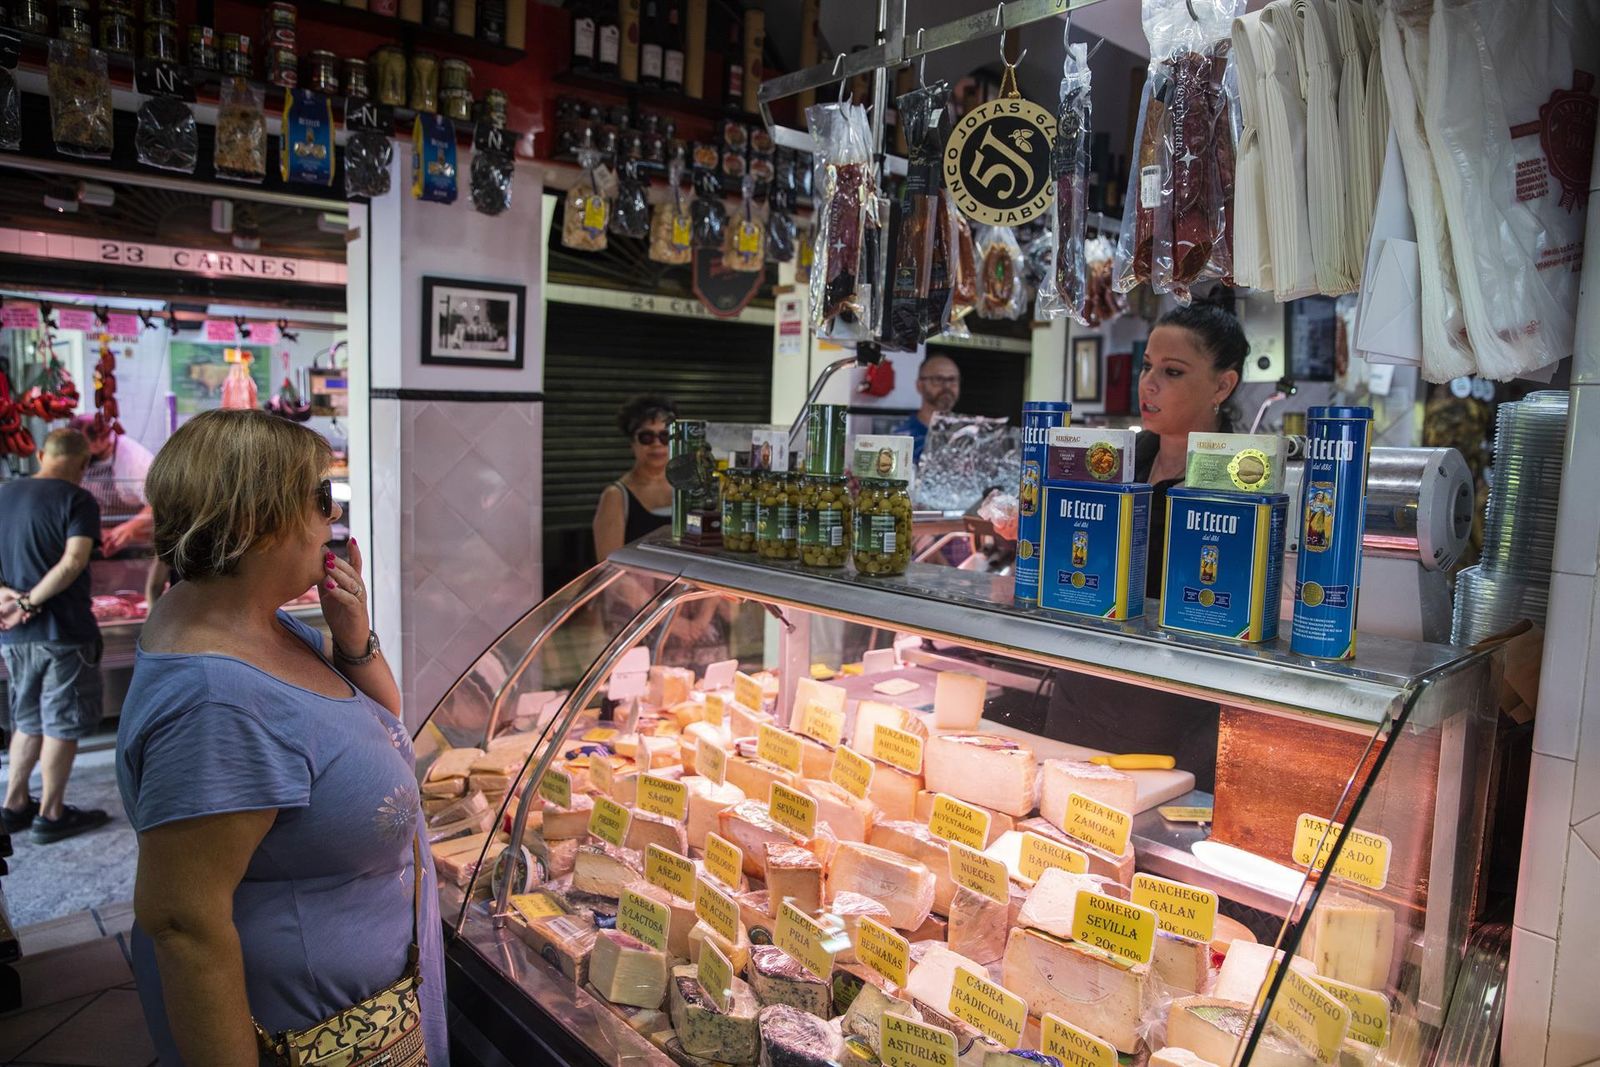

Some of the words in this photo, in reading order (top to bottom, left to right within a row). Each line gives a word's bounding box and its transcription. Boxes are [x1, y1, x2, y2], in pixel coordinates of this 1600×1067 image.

[959, 102, 1021, 139] JOTAS
[947, 147, 978, 213] CINCO
[993, 185, 1055, 223] JABUG
[101, 243, 144, 263] 23
[173, 251, 296, 277] CARNES
[670, 301, 705, 314] CAR
[1196, 441, 1227, 449] HERPAC
[1313, 437, 1353, 461] CECCO
[1060, 499, 1073, 518] DE
[1074, 500, 1104, 521] CECCO
[1187, 509, 1201, 530] DE
[1203, 511, 1237, 534] CECCO
[644, 776, 681, 793] PECORINO
[774, 786, 810, 808] PIMENTON
[647, 791, 674, 805] SARDO
[1072, 797, 1104, 818] OVEJA
[776, 802, 805, 822] SEVILLA
[945, 802, 973, 820] OVEJA
[933, 812, 983, 837] AUYENTALOBOS
[1073, 813, 1116, 839] ZAMORA
[648, 848, 674, 865] OVEJA
[676, 858, 691, 872] RON
[960, 849, 990, 867] OVEJA
[1033, 840, 1072, 863] GARCIA
[960, 862, 995, 884] NUECES
[629, 894, 655, 914] CABRA
[1138, 878, 1210, 905] MANCHEGO
[621, 905, 663, 935] S/LACTOSA
[709, 904, 733, 929] ACEITE
[1089, 896, 1141, 921] ROMERO
[1149, 899, 1196, 920] GALAN
[782, 905, 788, 916] 3
[789, 908, 823, 939] LECHES
[1086, 914, 1138, 941] SEVILLA
[789, 927, 810, 949] PRIA
[861, 921, 886, 942] OVEJA
[888, 936, 904, 952] DOS
[861, 936, 903, 970] HERMANAS
[1119, 947, 1142, 962] 100G
[966, 975, 1004, 1005] CABRA
[1285, 972, 1341, 1021] ANCHEGO
[1320, 984, 1361, 1005] BRA
[951, 985, 1021, 1034] TRADICIONAL
[1288, 997, 1316, 1026] SEMI
[887, 1018, 903, 1033] LA
[906, 1023, 946, 1046] PERAL
[1054, 1023, 1100, 1057] PAYOYA
[887, 1037, 947, 1065] ASTURIAS
[1049, 1040, 1096, 1067] MANTEC
